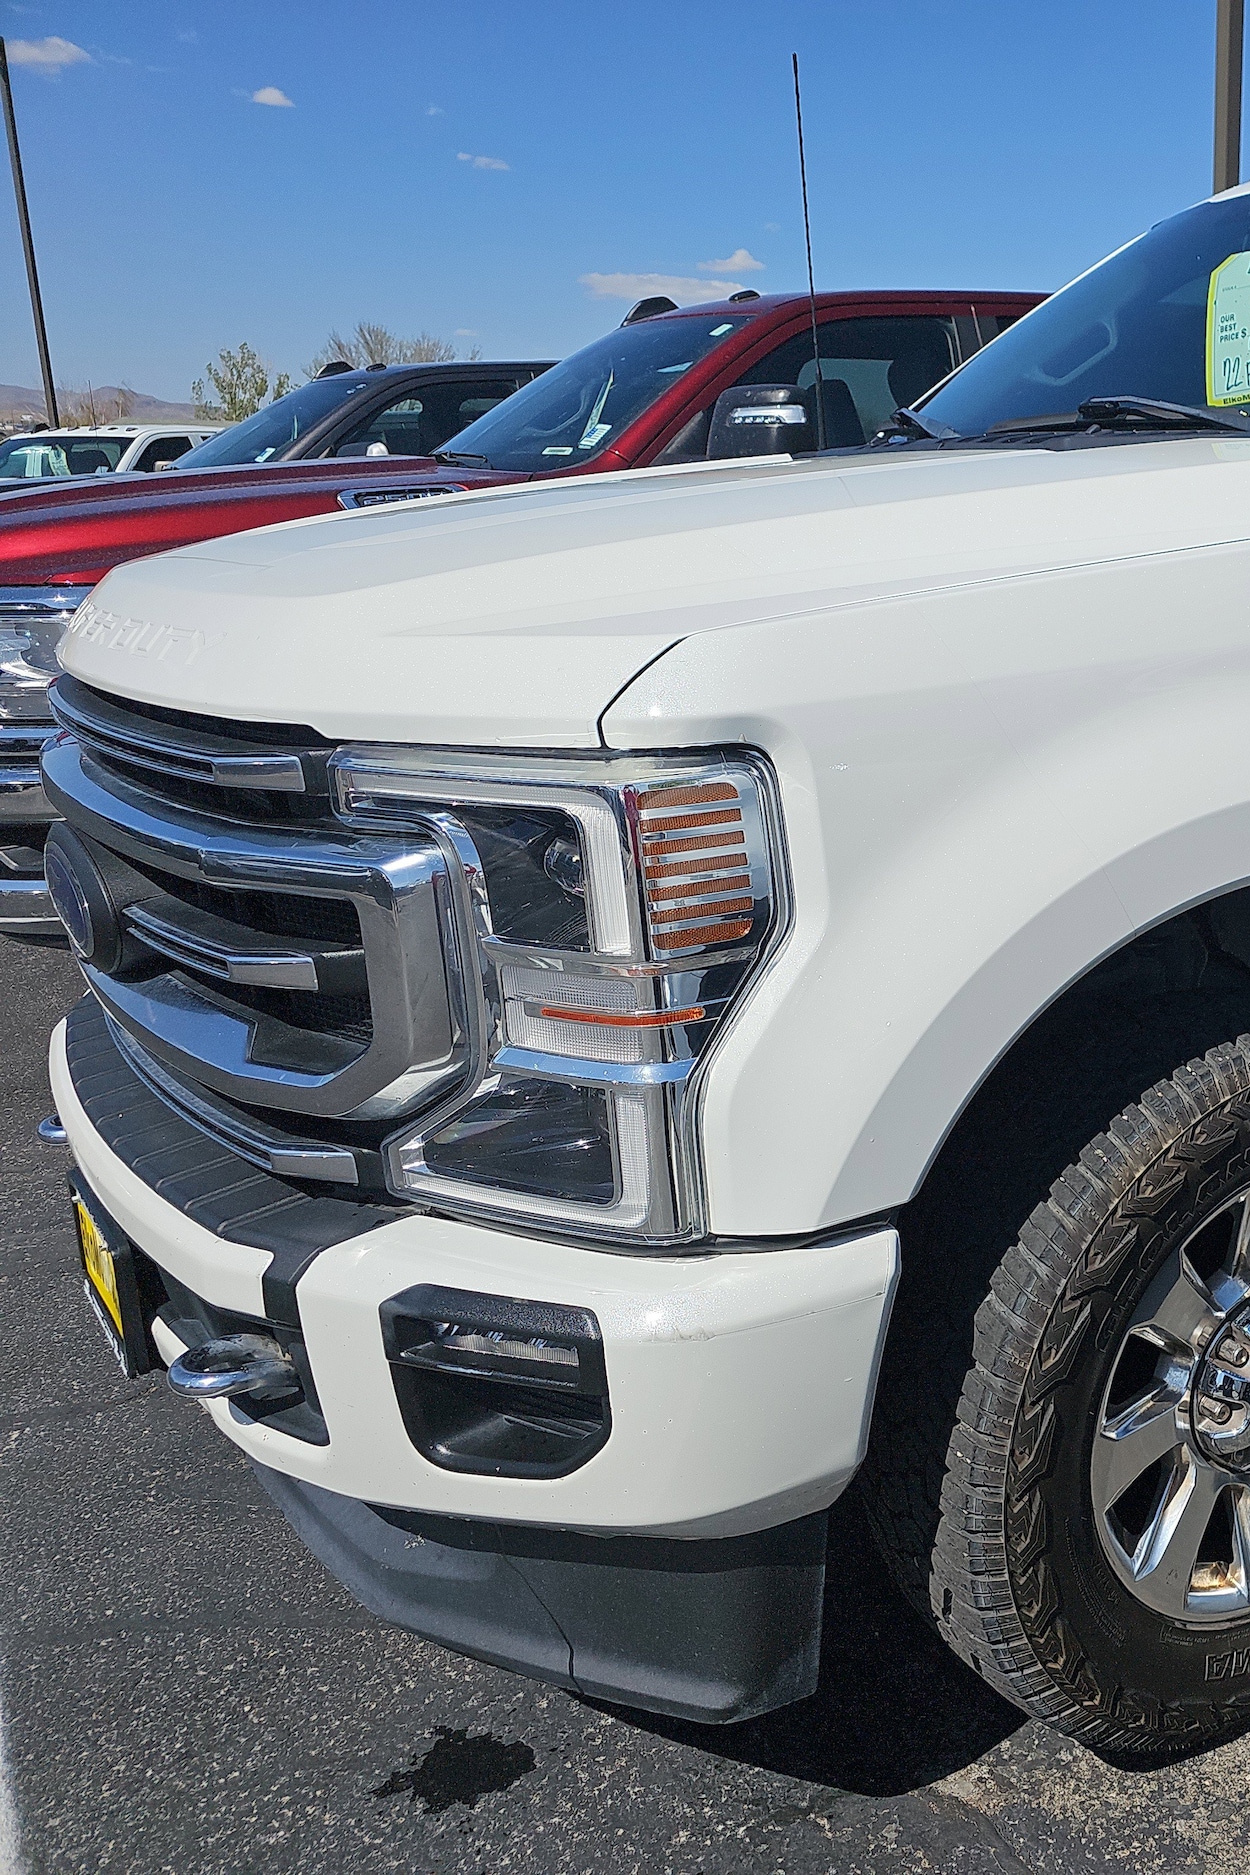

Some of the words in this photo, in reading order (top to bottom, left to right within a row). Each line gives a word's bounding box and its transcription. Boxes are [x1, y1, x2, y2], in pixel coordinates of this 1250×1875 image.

[1220, 313, 1235, 323] OUR
[1220, 322, 1237, 333] BEST
[1219, 332, 1239, 343] PRICE
[1240, 328, 1247, 339] $
[107, 617, 228, 666] DUTY
